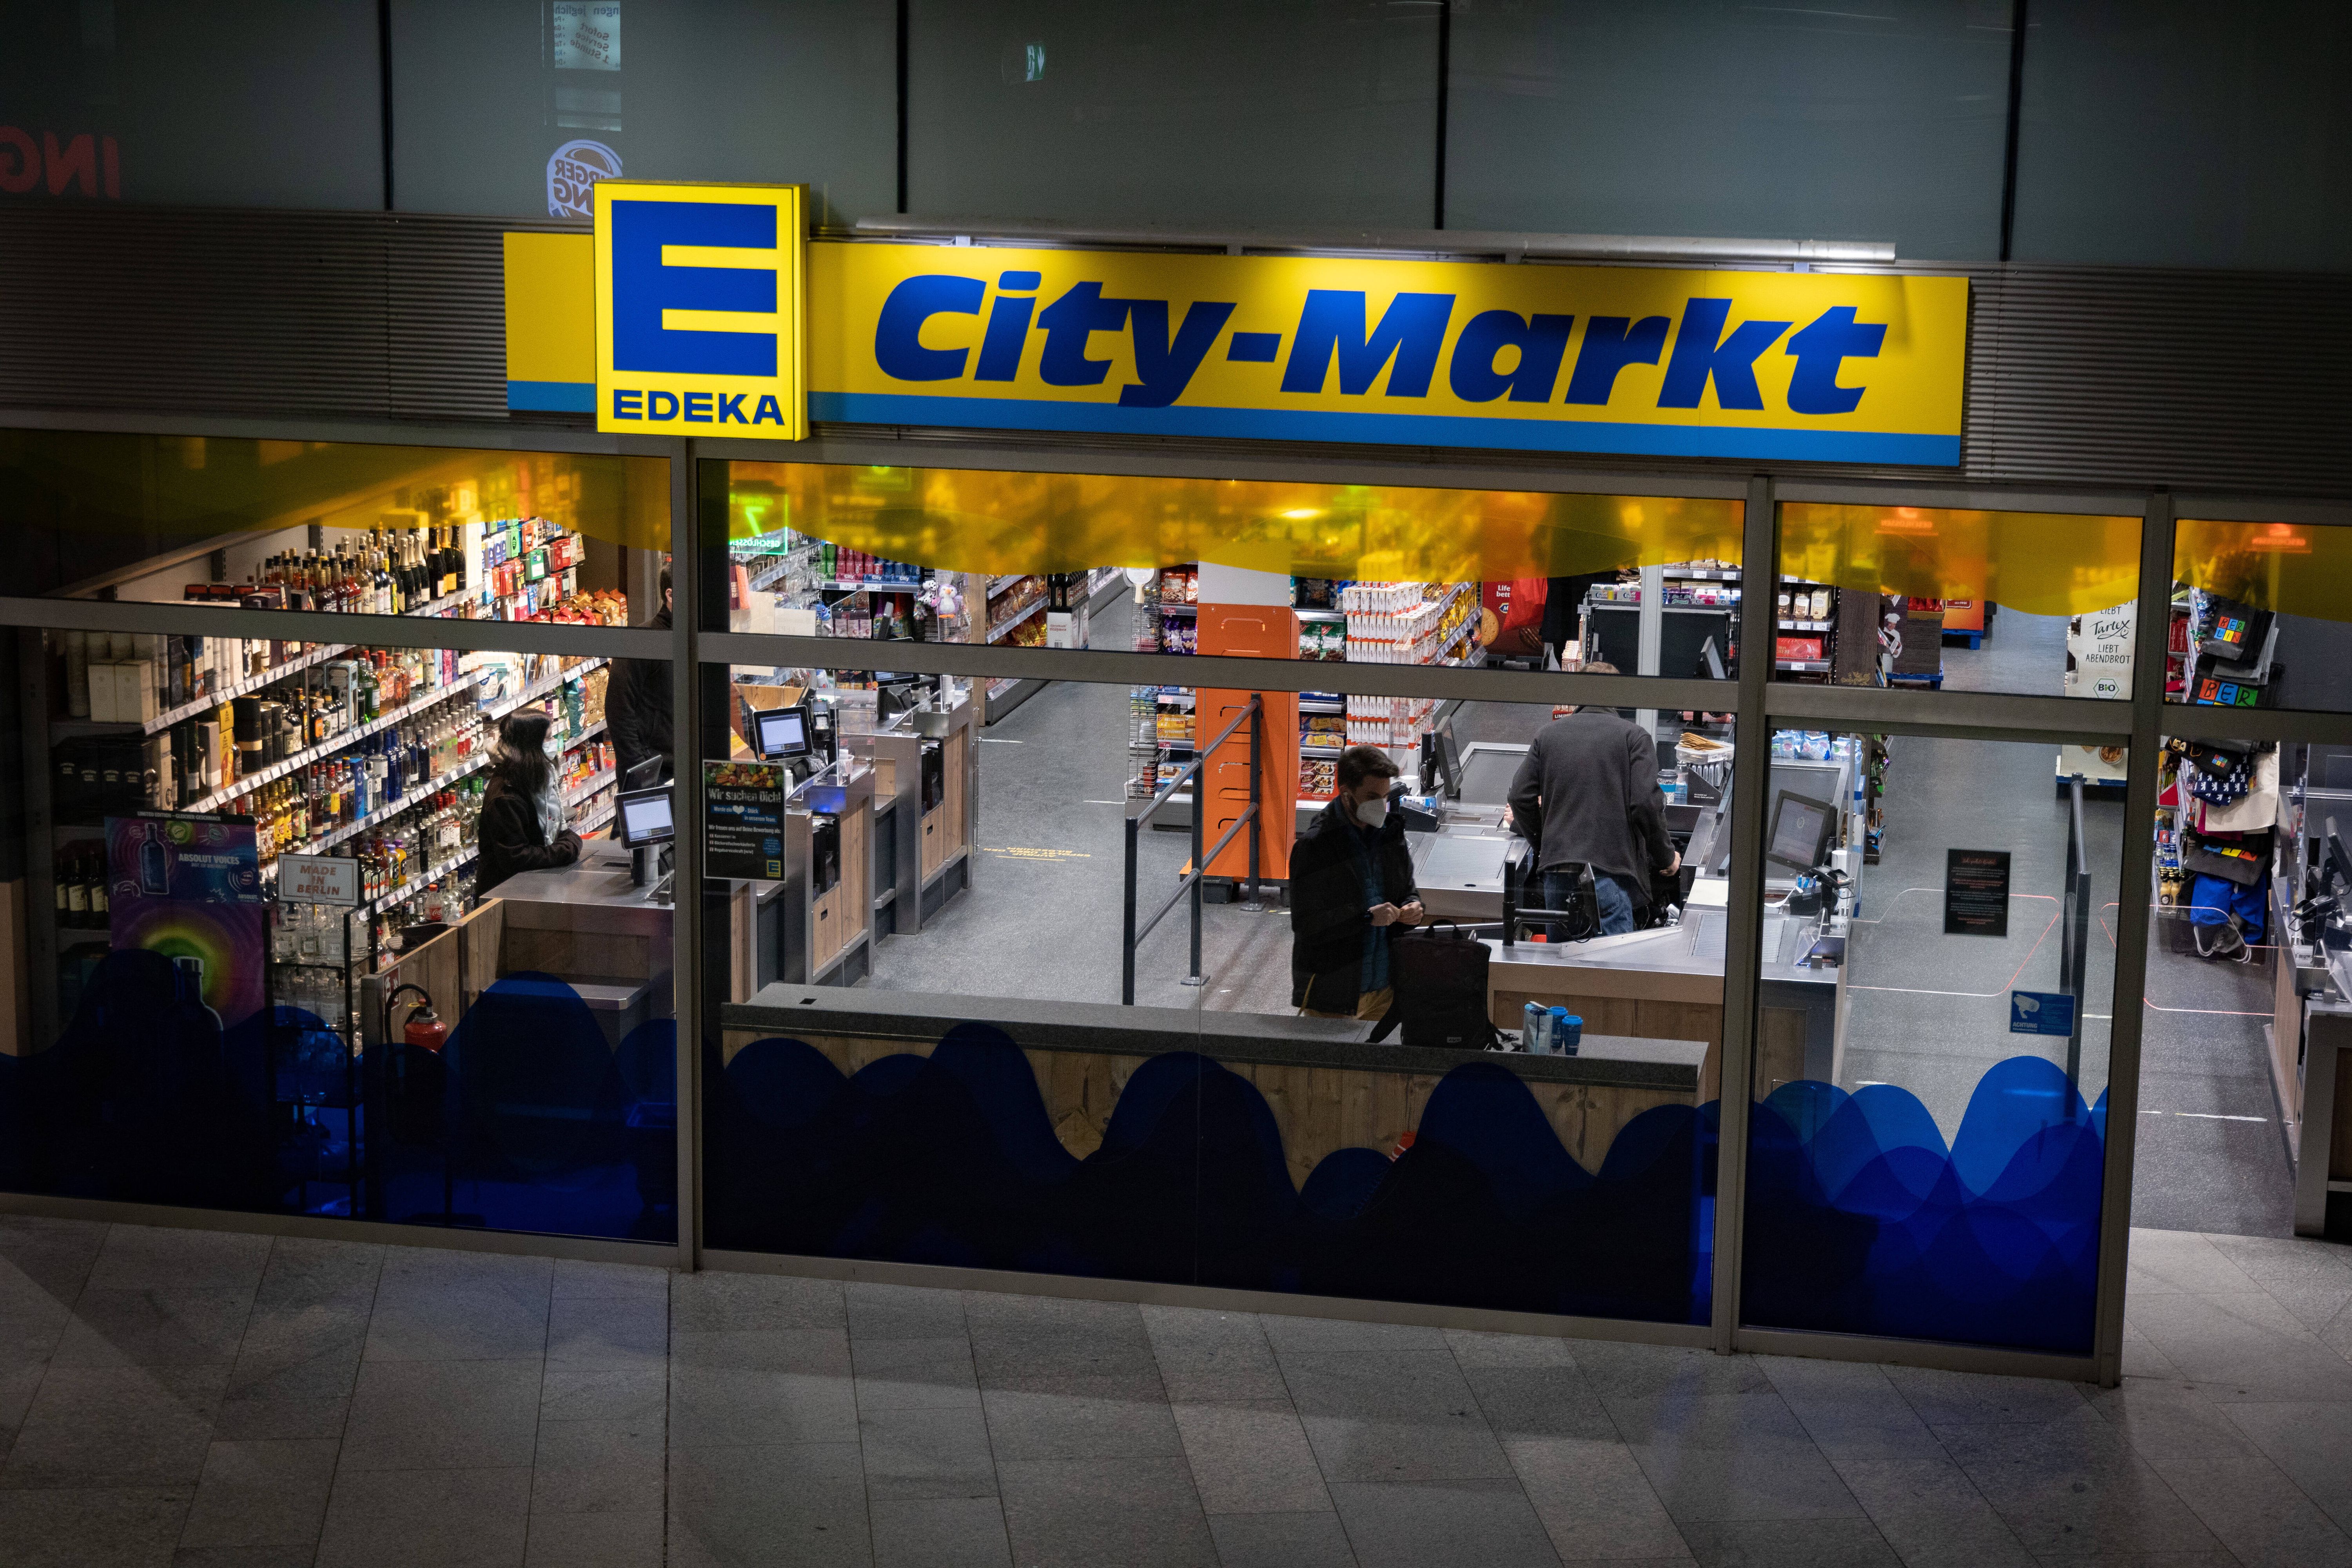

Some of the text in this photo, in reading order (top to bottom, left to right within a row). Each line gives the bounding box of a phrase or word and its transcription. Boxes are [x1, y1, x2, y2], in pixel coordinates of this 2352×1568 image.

[611, 200, 778, 377] E
[874, 270, 1888, 415] City-Markt
[613, 389, 785, 426] EDEKA
[2089, 619, 2131, 639] Tartex
[2098, 644, 2119, 653] LIEBT
[2085, 653, 2131, 664] ABENDBROT
[2204, 682, 2254, 706] BER
[708, 788, 781, 803] Wir suchen Dich!
[179, 853, 240, 865] ABSOLUT VOICES
[300, 865, 337, 876] MADE
[312, 876, 325, 885] IN
[297, 884, 340, 895] BERLIN
